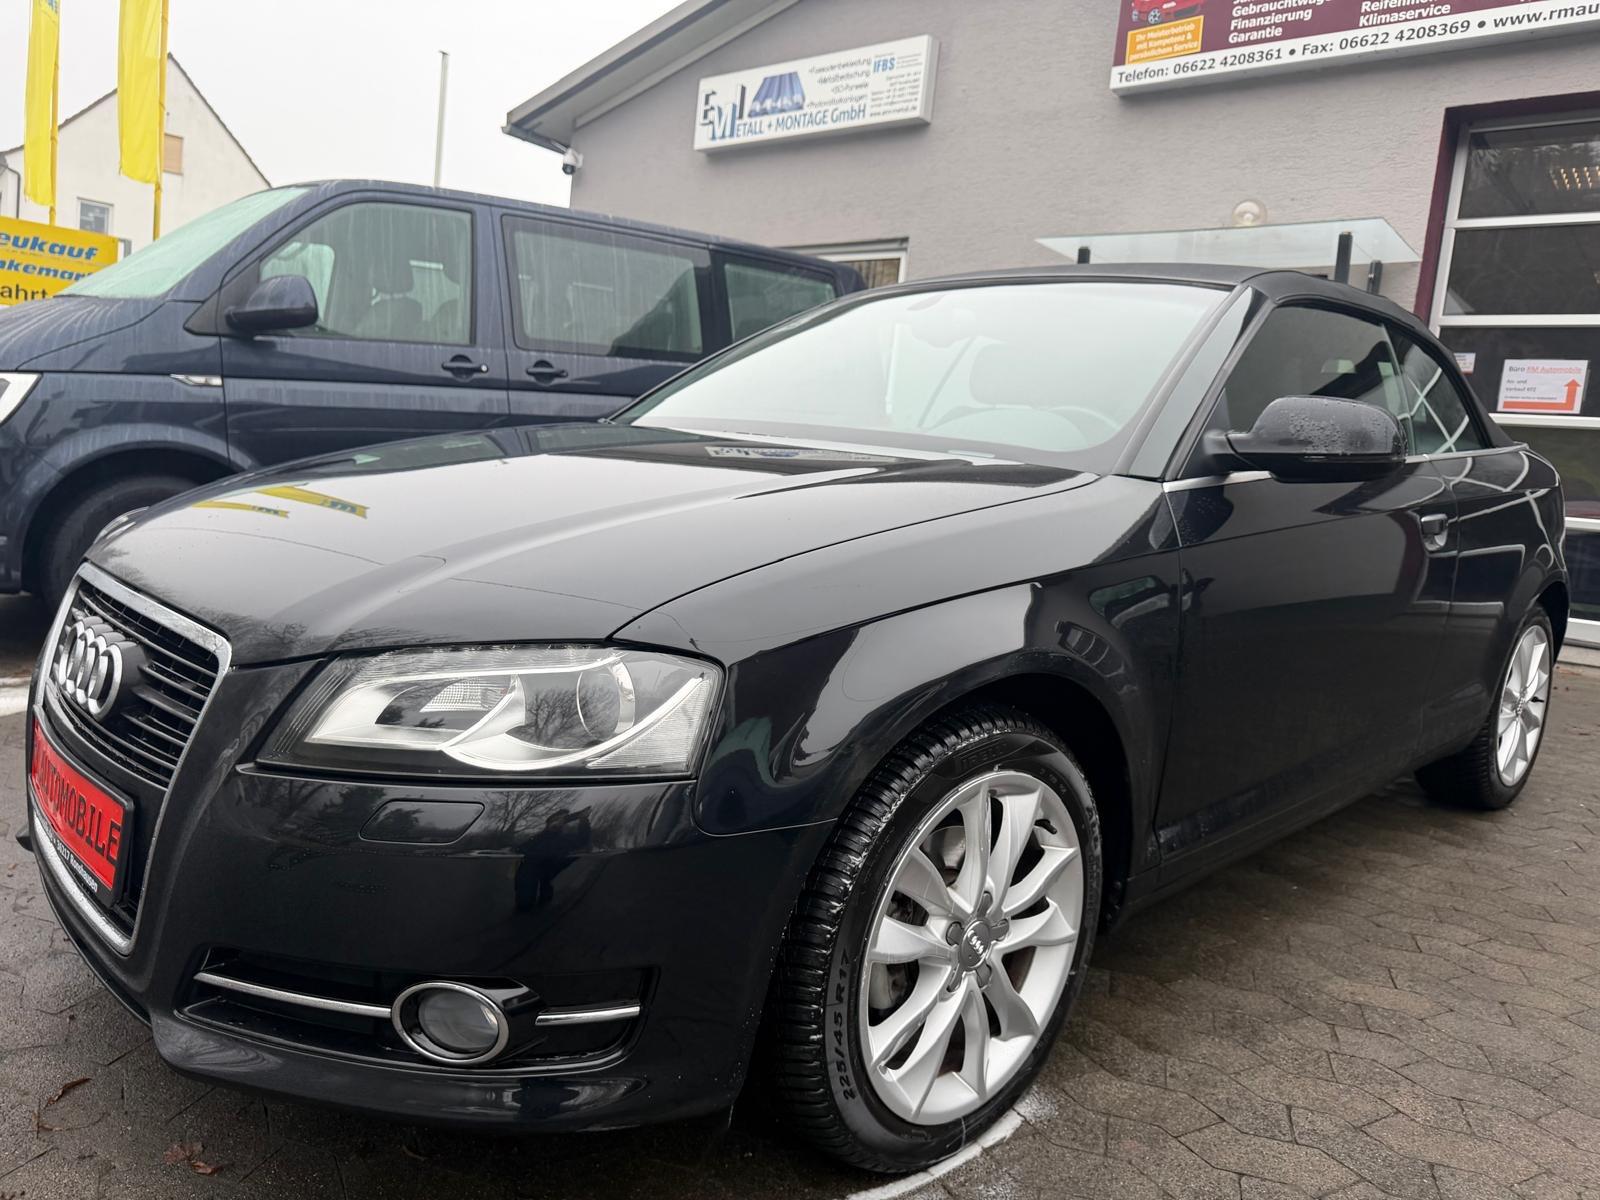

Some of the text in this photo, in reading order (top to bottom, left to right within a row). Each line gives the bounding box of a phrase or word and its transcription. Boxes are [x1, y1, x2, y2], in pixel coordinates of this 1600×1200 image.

[1230, 9, 1313, 31] Finanzierung
[1358, 4, 1452, 27] Klimaservice
[1228, 25, 1283, 44] Garantie
[1118, 66, 1169, 83] Telefon:
[1173, 58, 1216, 75] 06622
[1219, 47, 1283, 68] 4208361
[1302, 41, 1334, 56] Fax:
[1339, 32, 1390, 50] 06622
[1394, 20, 1471, 42] 4208369
[873, 57, 896, 74] IFBS
[775, 109, 830, 133] MONTAGE
[830, 103, 867, 123] GmbH
[0, 259, 93, 282] kemar
